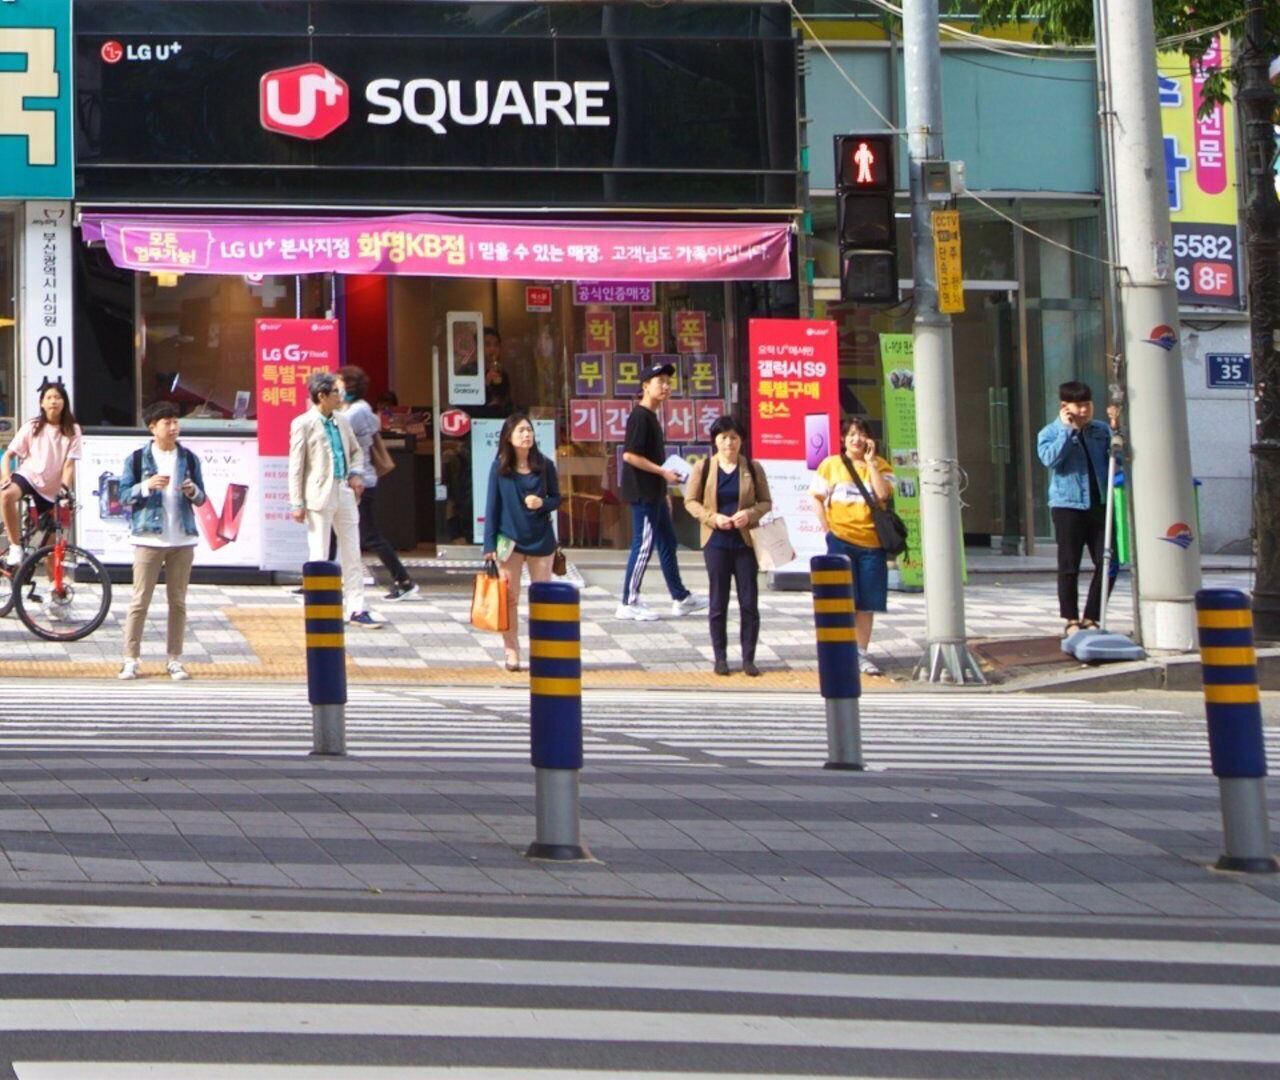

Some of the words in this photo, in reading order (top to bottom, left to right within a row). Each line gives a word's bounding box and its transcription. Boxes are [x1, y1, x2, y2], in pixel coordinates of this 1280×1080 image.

[127, 44, 152, 61] LG
[365, 77, 611, 134] SQUARE
[150, 231, 178, 247] 모든
[221, 242, 246, 259] LG
[280, 238, 351, 258] 본사지정
[357, 230, 466, 265] 화명KB점
[478, 241, 509, 261] 믿을
[513, 243, 530, 261] 수
[533, 243, 564, 262] 있는
[611, 245, 674, 263] 고객님도
[43, 231, 58, 289] 부산광역시
[578, 286, 651, 301] 공식인증매장
[43, 293, 58, 328] 시의원
[262, 348, 281, 361] LG
[578, 361, 715, 391] 부모폰
[758, 360, 802, 378] 갤럭시
[803, 361, 826, 377] S9
[1221, 364, 1242, 379] 35
[262, 386, 297, 407] 혜택
[454, 387, 479, 396] Galaxy
[758, 381, 820, 399] 특별구매
[758, 401, 791, 419] 찬스
[574, 406, 722, 436] 기간사중
